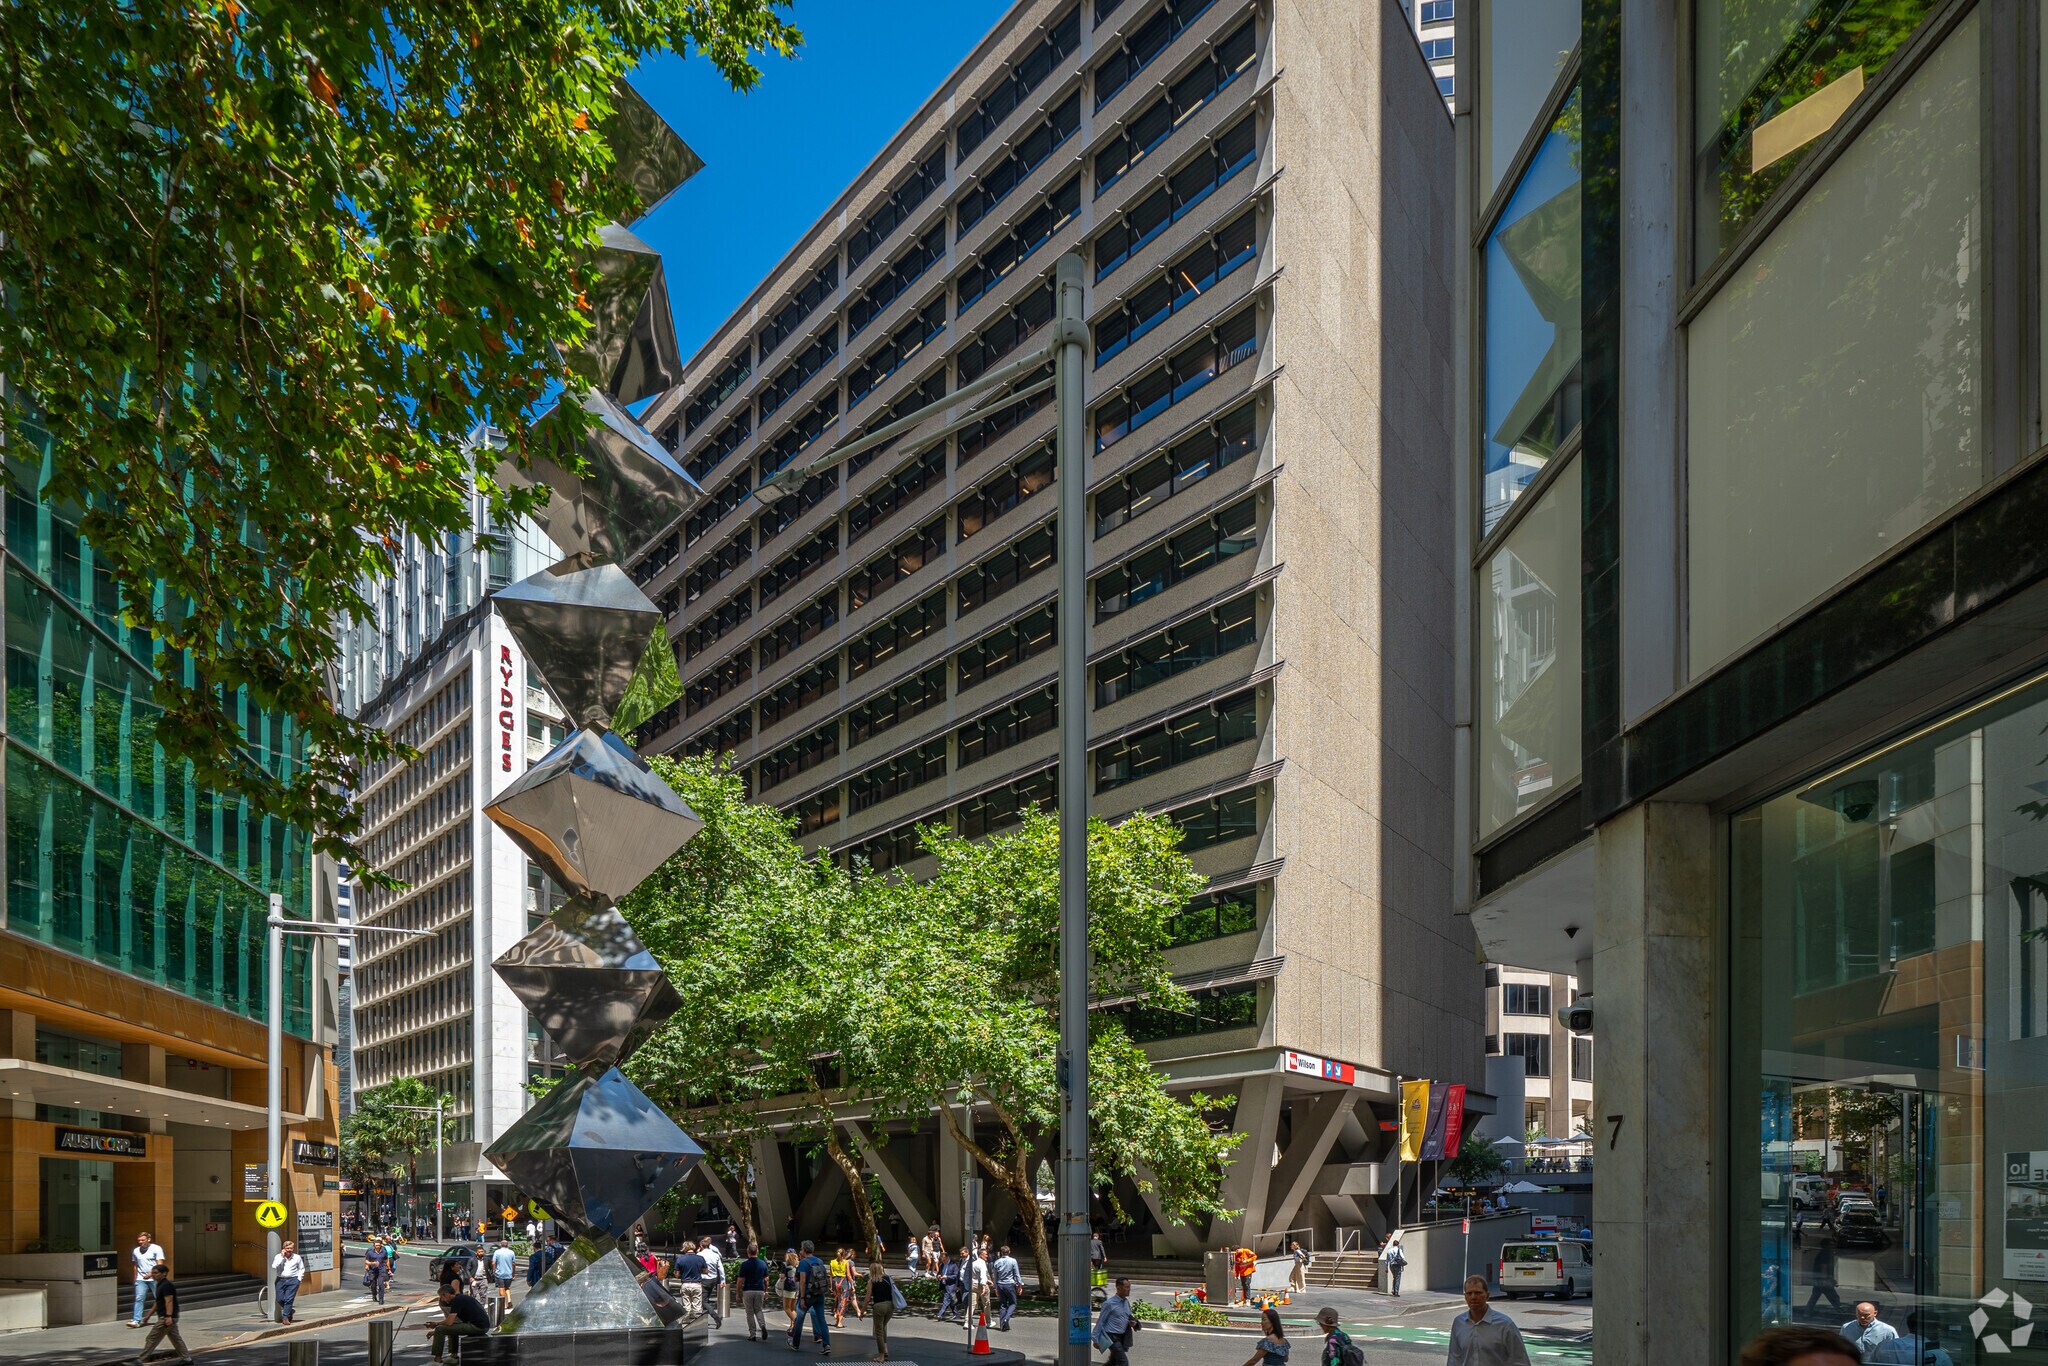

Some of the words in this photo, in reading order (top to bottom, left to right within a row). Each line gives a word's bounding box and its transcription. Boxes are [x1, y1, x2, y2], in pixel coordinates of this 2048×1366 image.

[500, 645, 514, 772] RYDGES
[1298, 1058, 1316, 1070] Wilson
[1607, 1115, 1625, 1150] 7
[61, 1133, 131, 1152] AUSTCORP
[298, 1215, 310, 1227] FOR
[311, 1215, 326, 1226] LEASE
